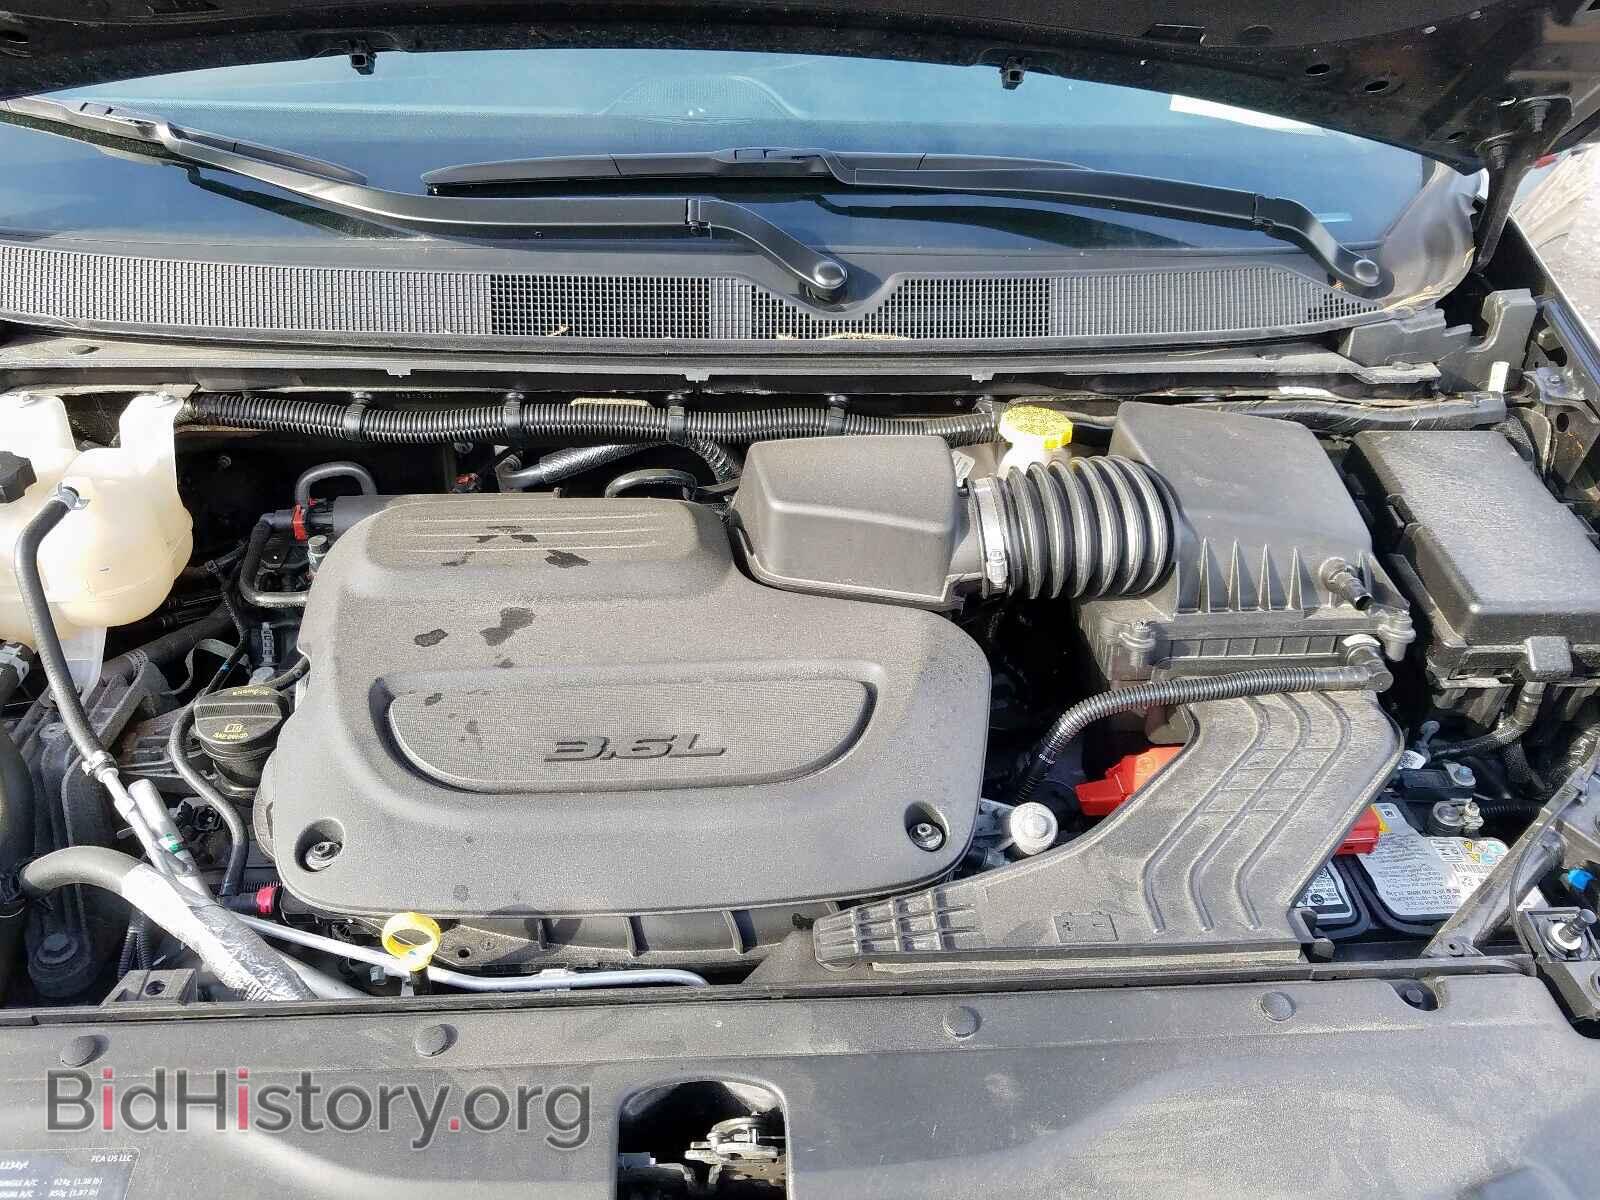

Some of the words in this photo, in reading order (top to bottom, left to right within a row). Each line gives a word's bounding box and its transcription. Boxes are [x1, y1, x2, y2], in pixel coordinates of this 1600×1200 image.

[544, 734, 728, 762] 3.6L
[91, 1154, 106, 1162] FCA
[107, 1154, 118, 1162] US
[119, 1154, 133, 1162] LLC
